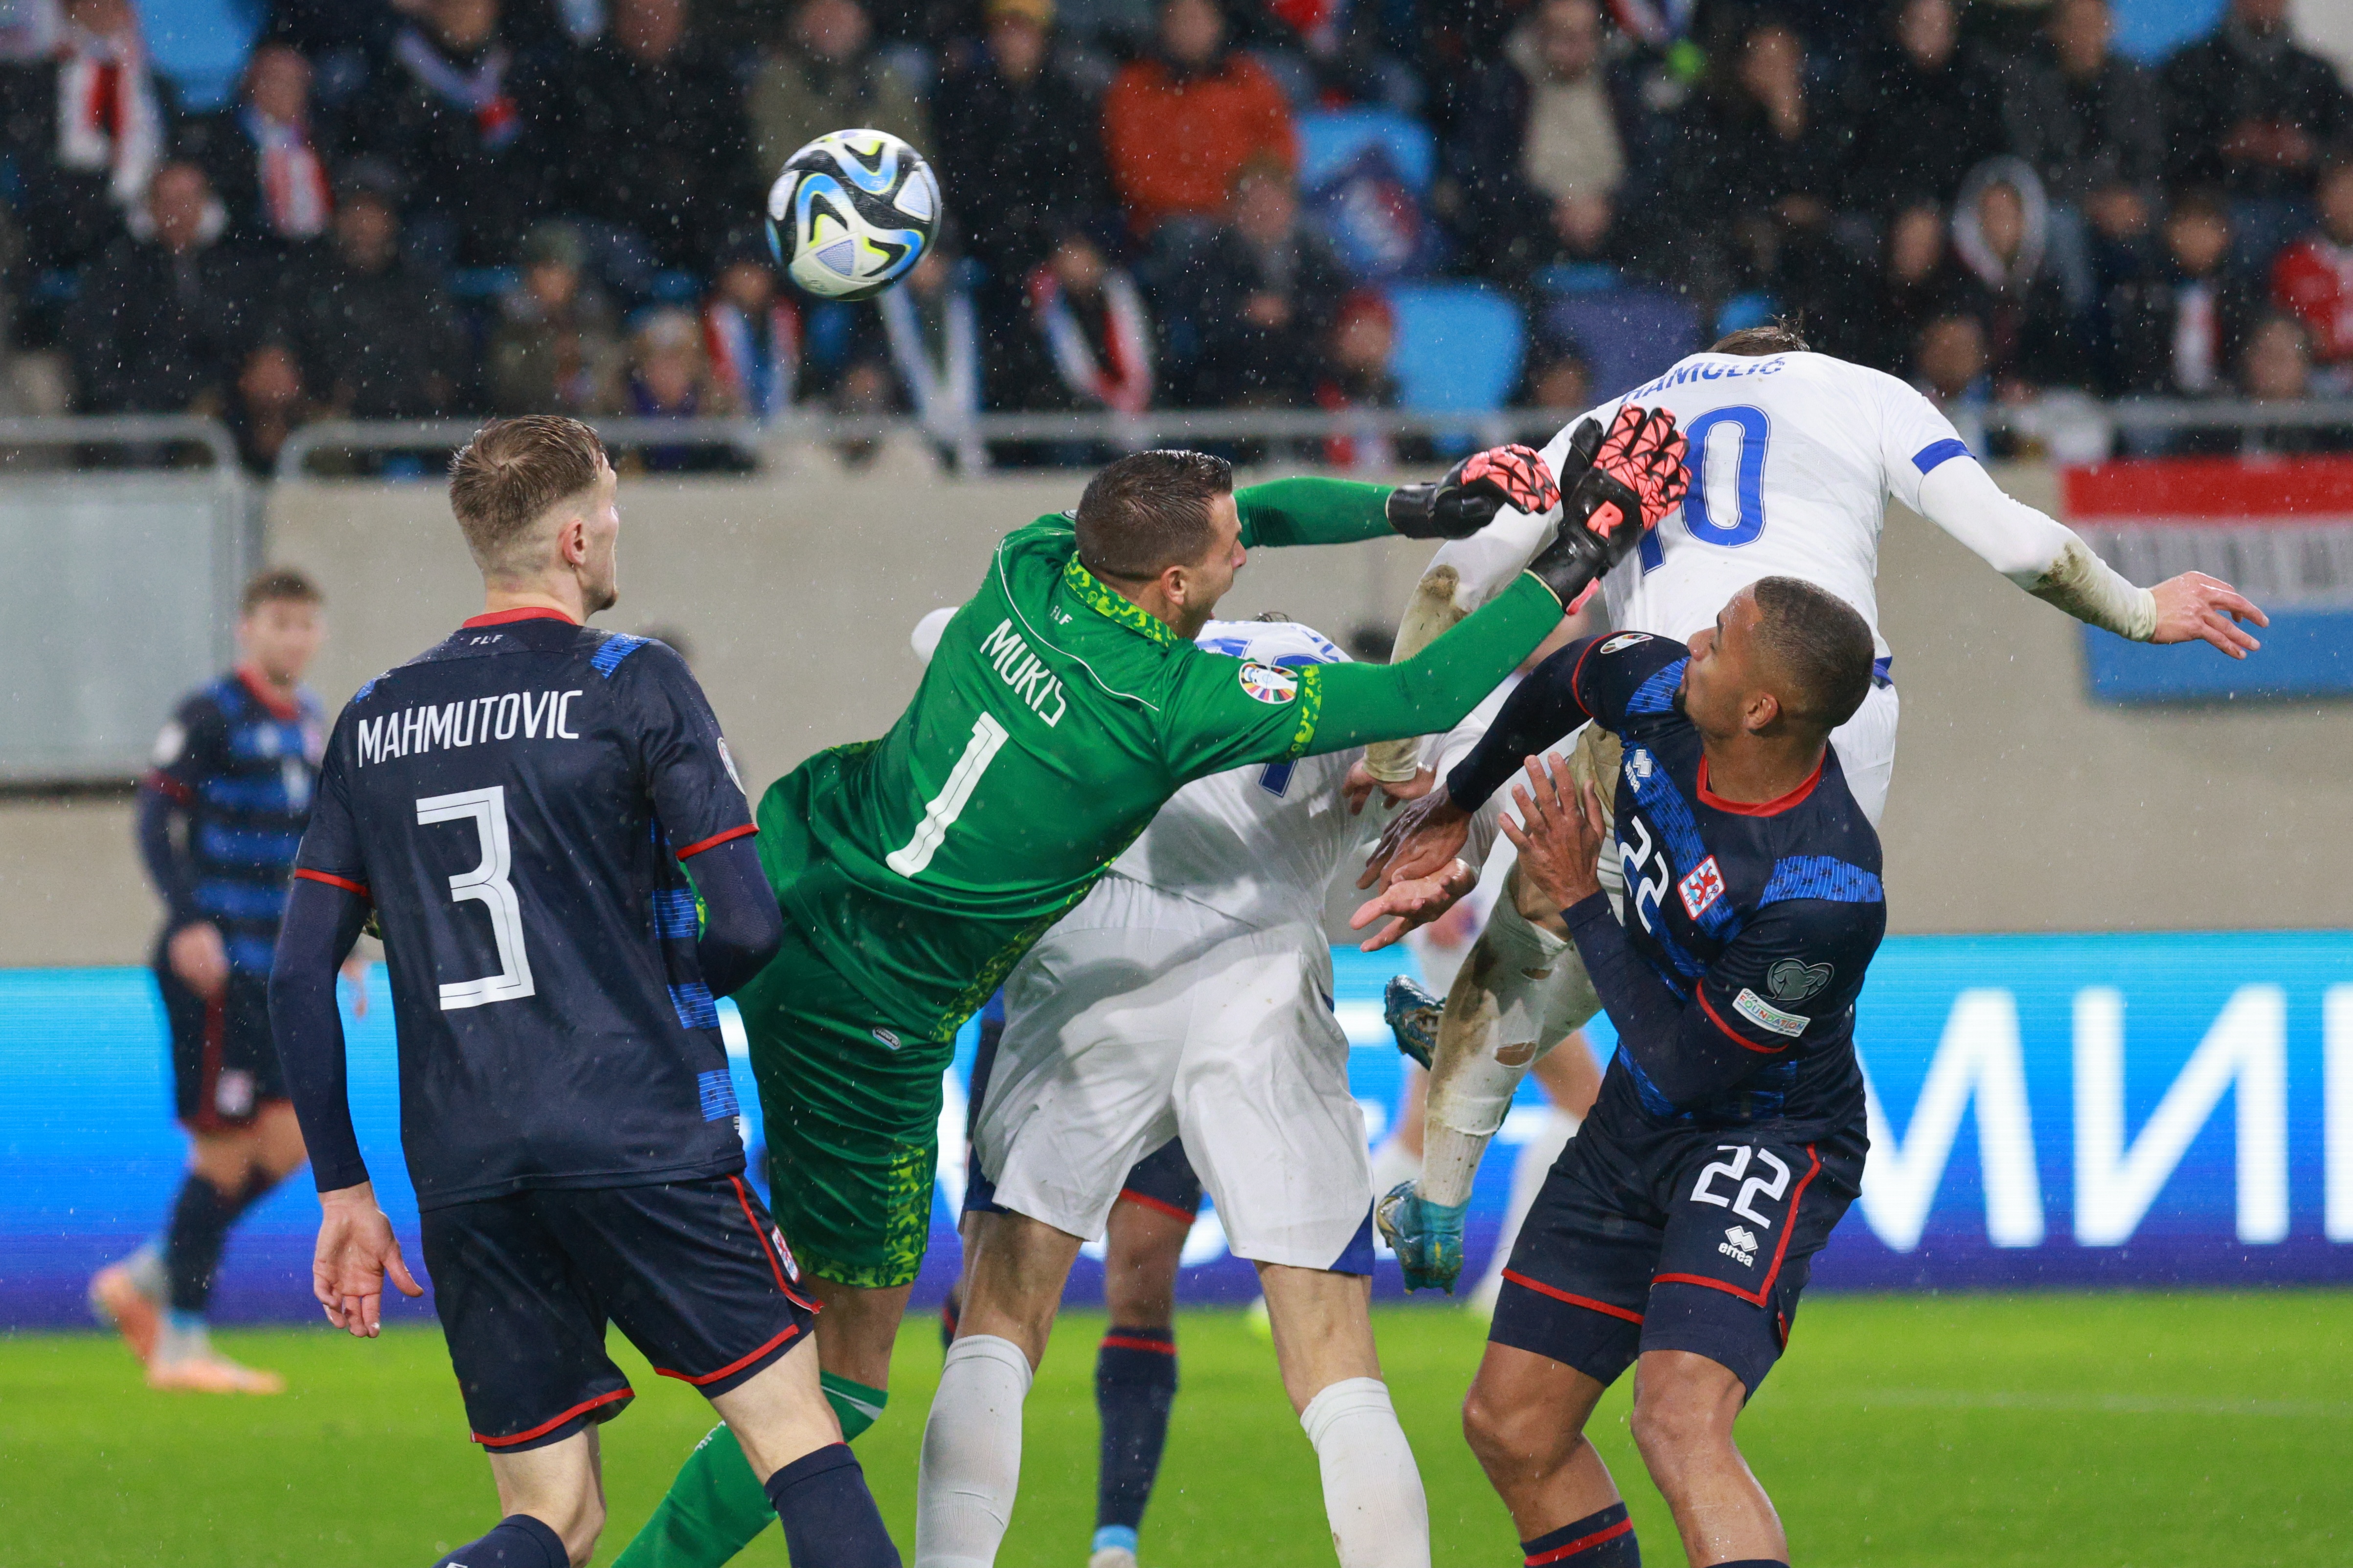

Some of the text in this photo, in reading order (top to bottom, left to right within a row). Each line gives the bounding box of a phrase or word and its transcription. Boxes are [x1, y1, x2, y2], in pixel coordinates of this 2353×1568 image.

[358, 690, 583, 768] MAHMUTOVIC
[886, 711, 1010, 878] 1
[415, 785, 536, 1010] 3
[1619, 815, 1669, 934] 22
[1739, 994, 1805, 1030] FOUNDATION
[1690, 1145, 1790, 1230] 22
